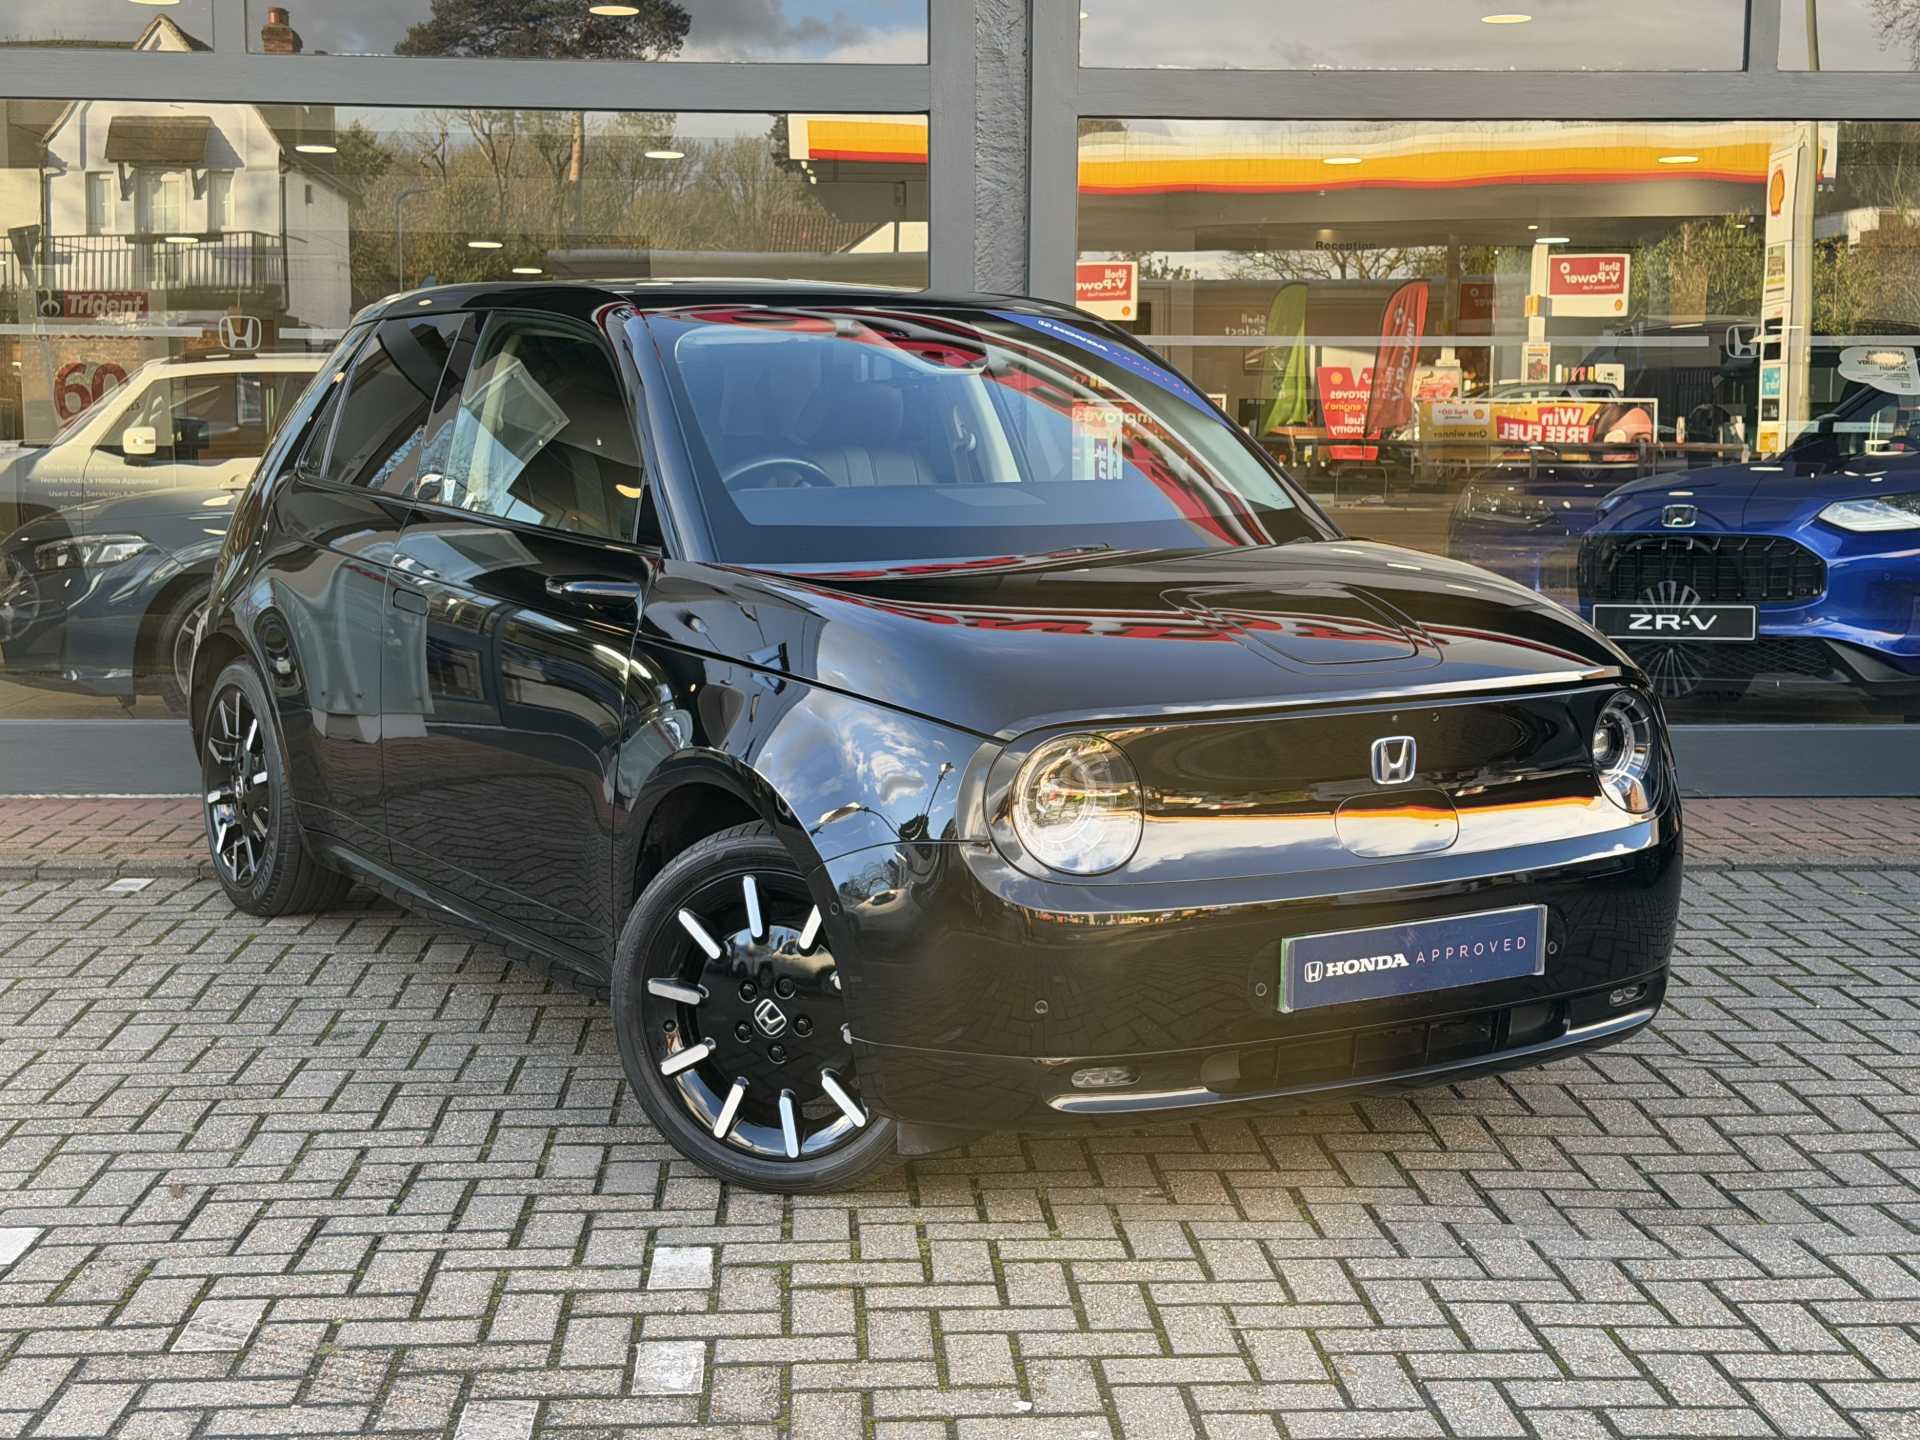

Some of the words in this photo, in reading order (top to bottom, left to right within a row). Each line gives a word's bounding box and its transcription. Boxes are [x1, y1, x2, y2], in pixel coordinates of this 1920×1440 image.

[1315, 240, 1377, 251] Reception
[67, 294, 144, 316] Trident
[1628, 613, 1718, 631] ZR-V
[1325, 953, 1410, 977] HONDA
[1415, 935, 1527, 964] APPROVED
